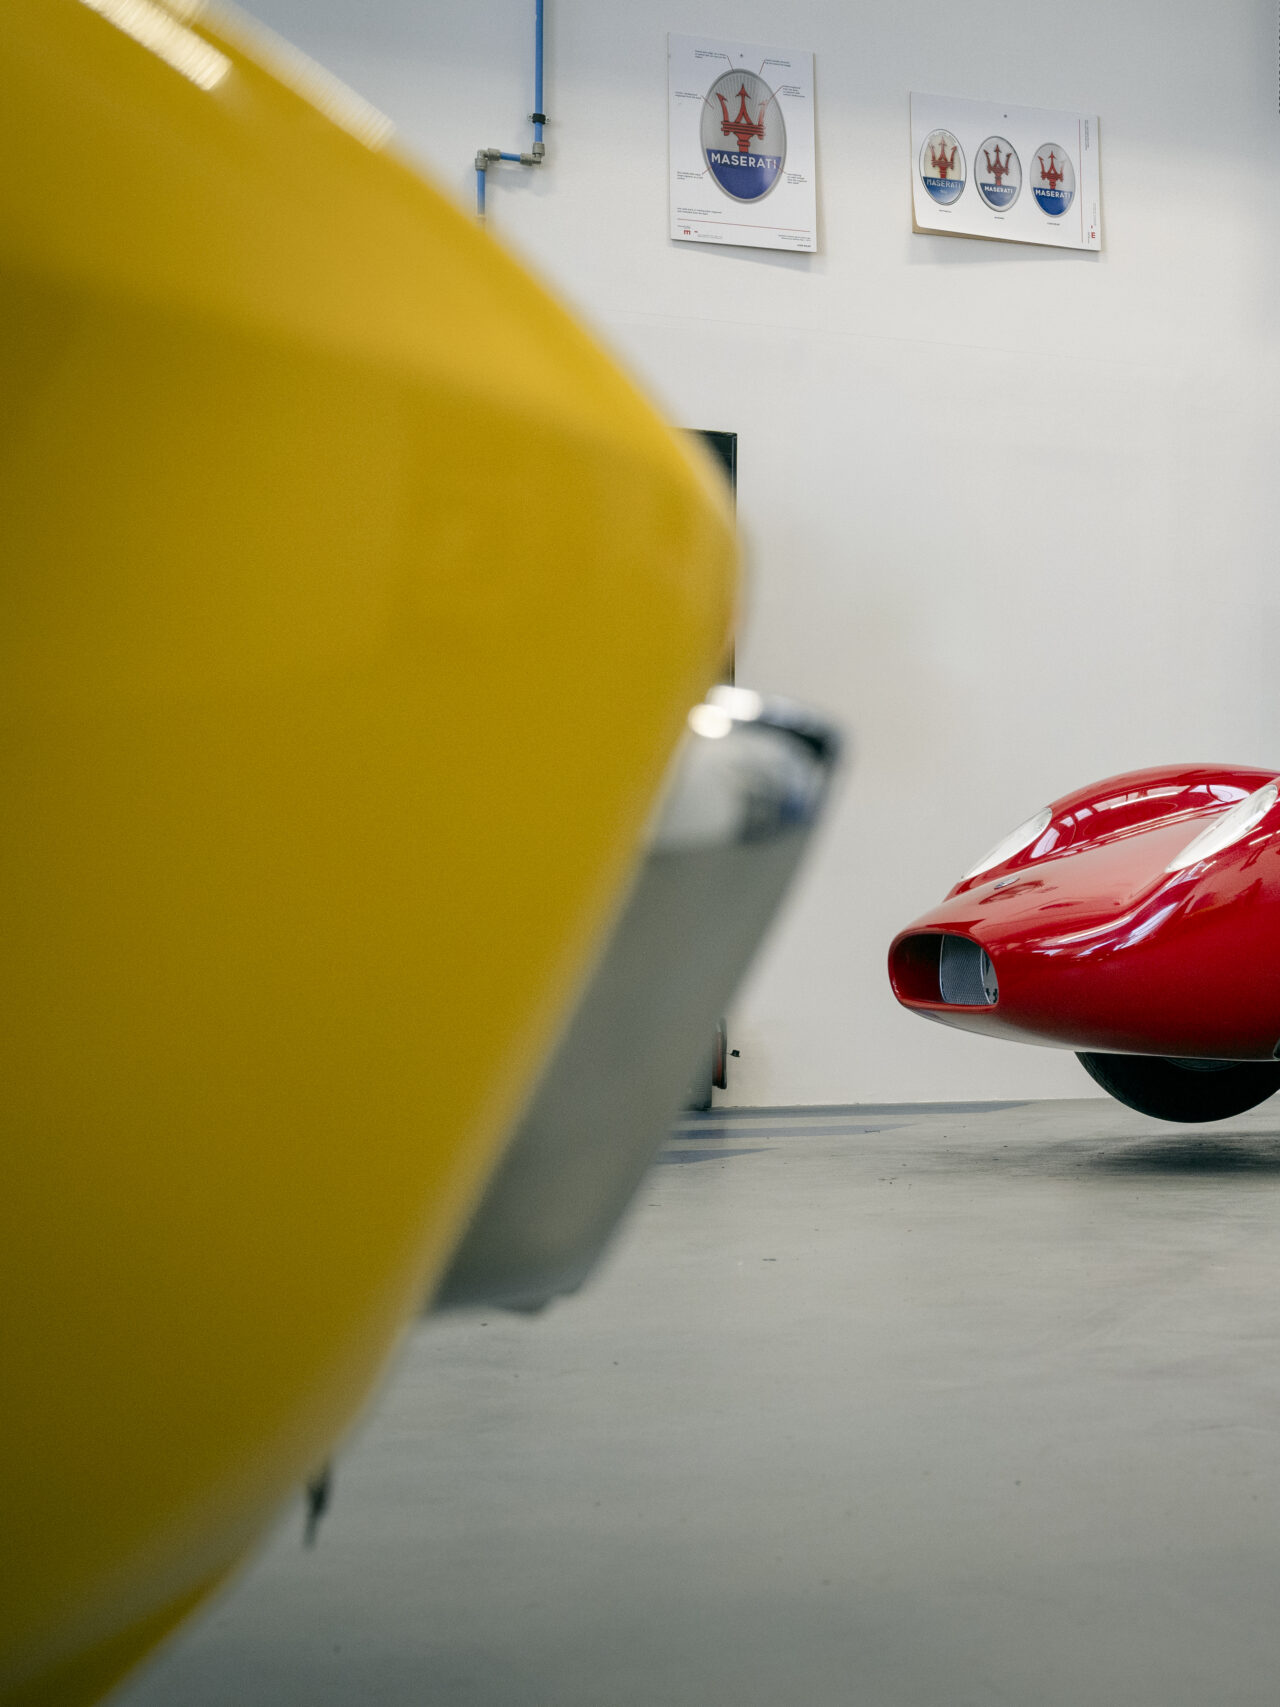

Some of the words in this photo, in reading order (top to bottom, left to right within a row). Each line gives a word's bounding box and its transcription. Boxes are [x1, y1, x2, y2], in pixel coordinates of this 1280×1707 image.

[711, 152, 777, 170] MASERATI
[926, 178, 961, 190] MASERATI
[984, 185, 1013, 194] MASERATI
[1034, 189, 1071, 199] MASERATI
